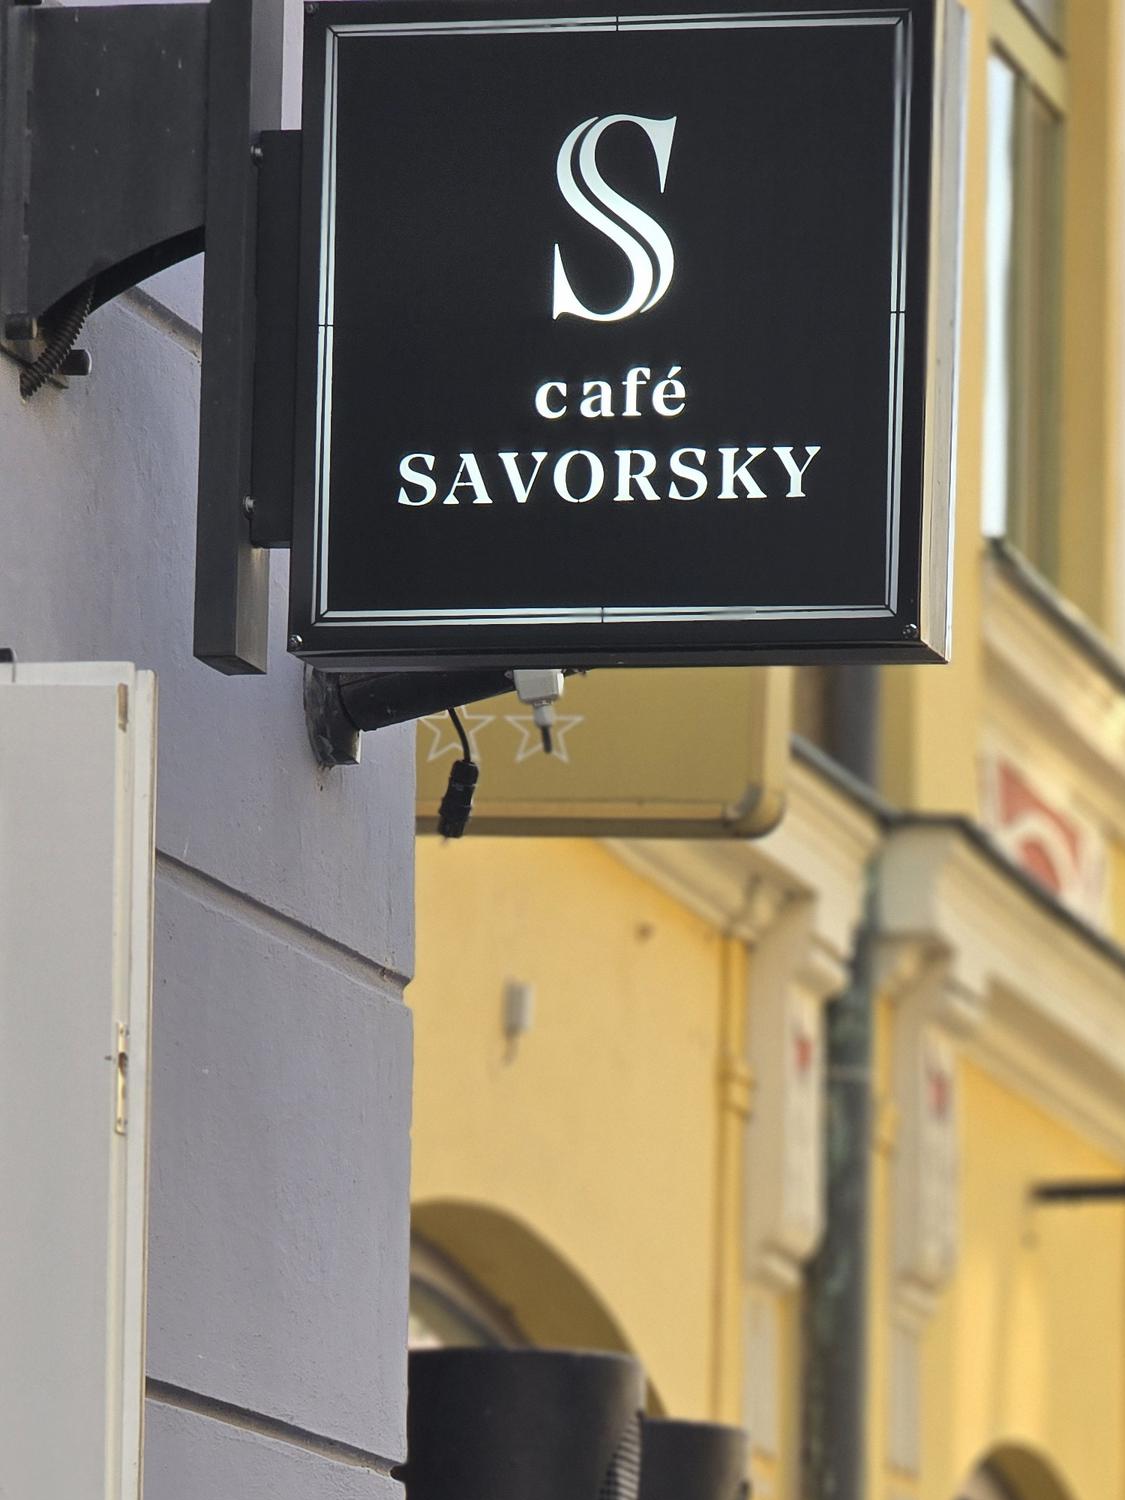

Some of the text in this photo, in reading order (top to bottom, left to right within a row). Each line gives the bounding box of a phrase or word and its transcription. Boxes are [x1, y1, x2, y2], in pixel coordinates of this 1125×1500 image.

[553, 114, 677, 321] S
[535, 366, 686, 419] café
[398, 446, 822, 506] SAVORSKY
